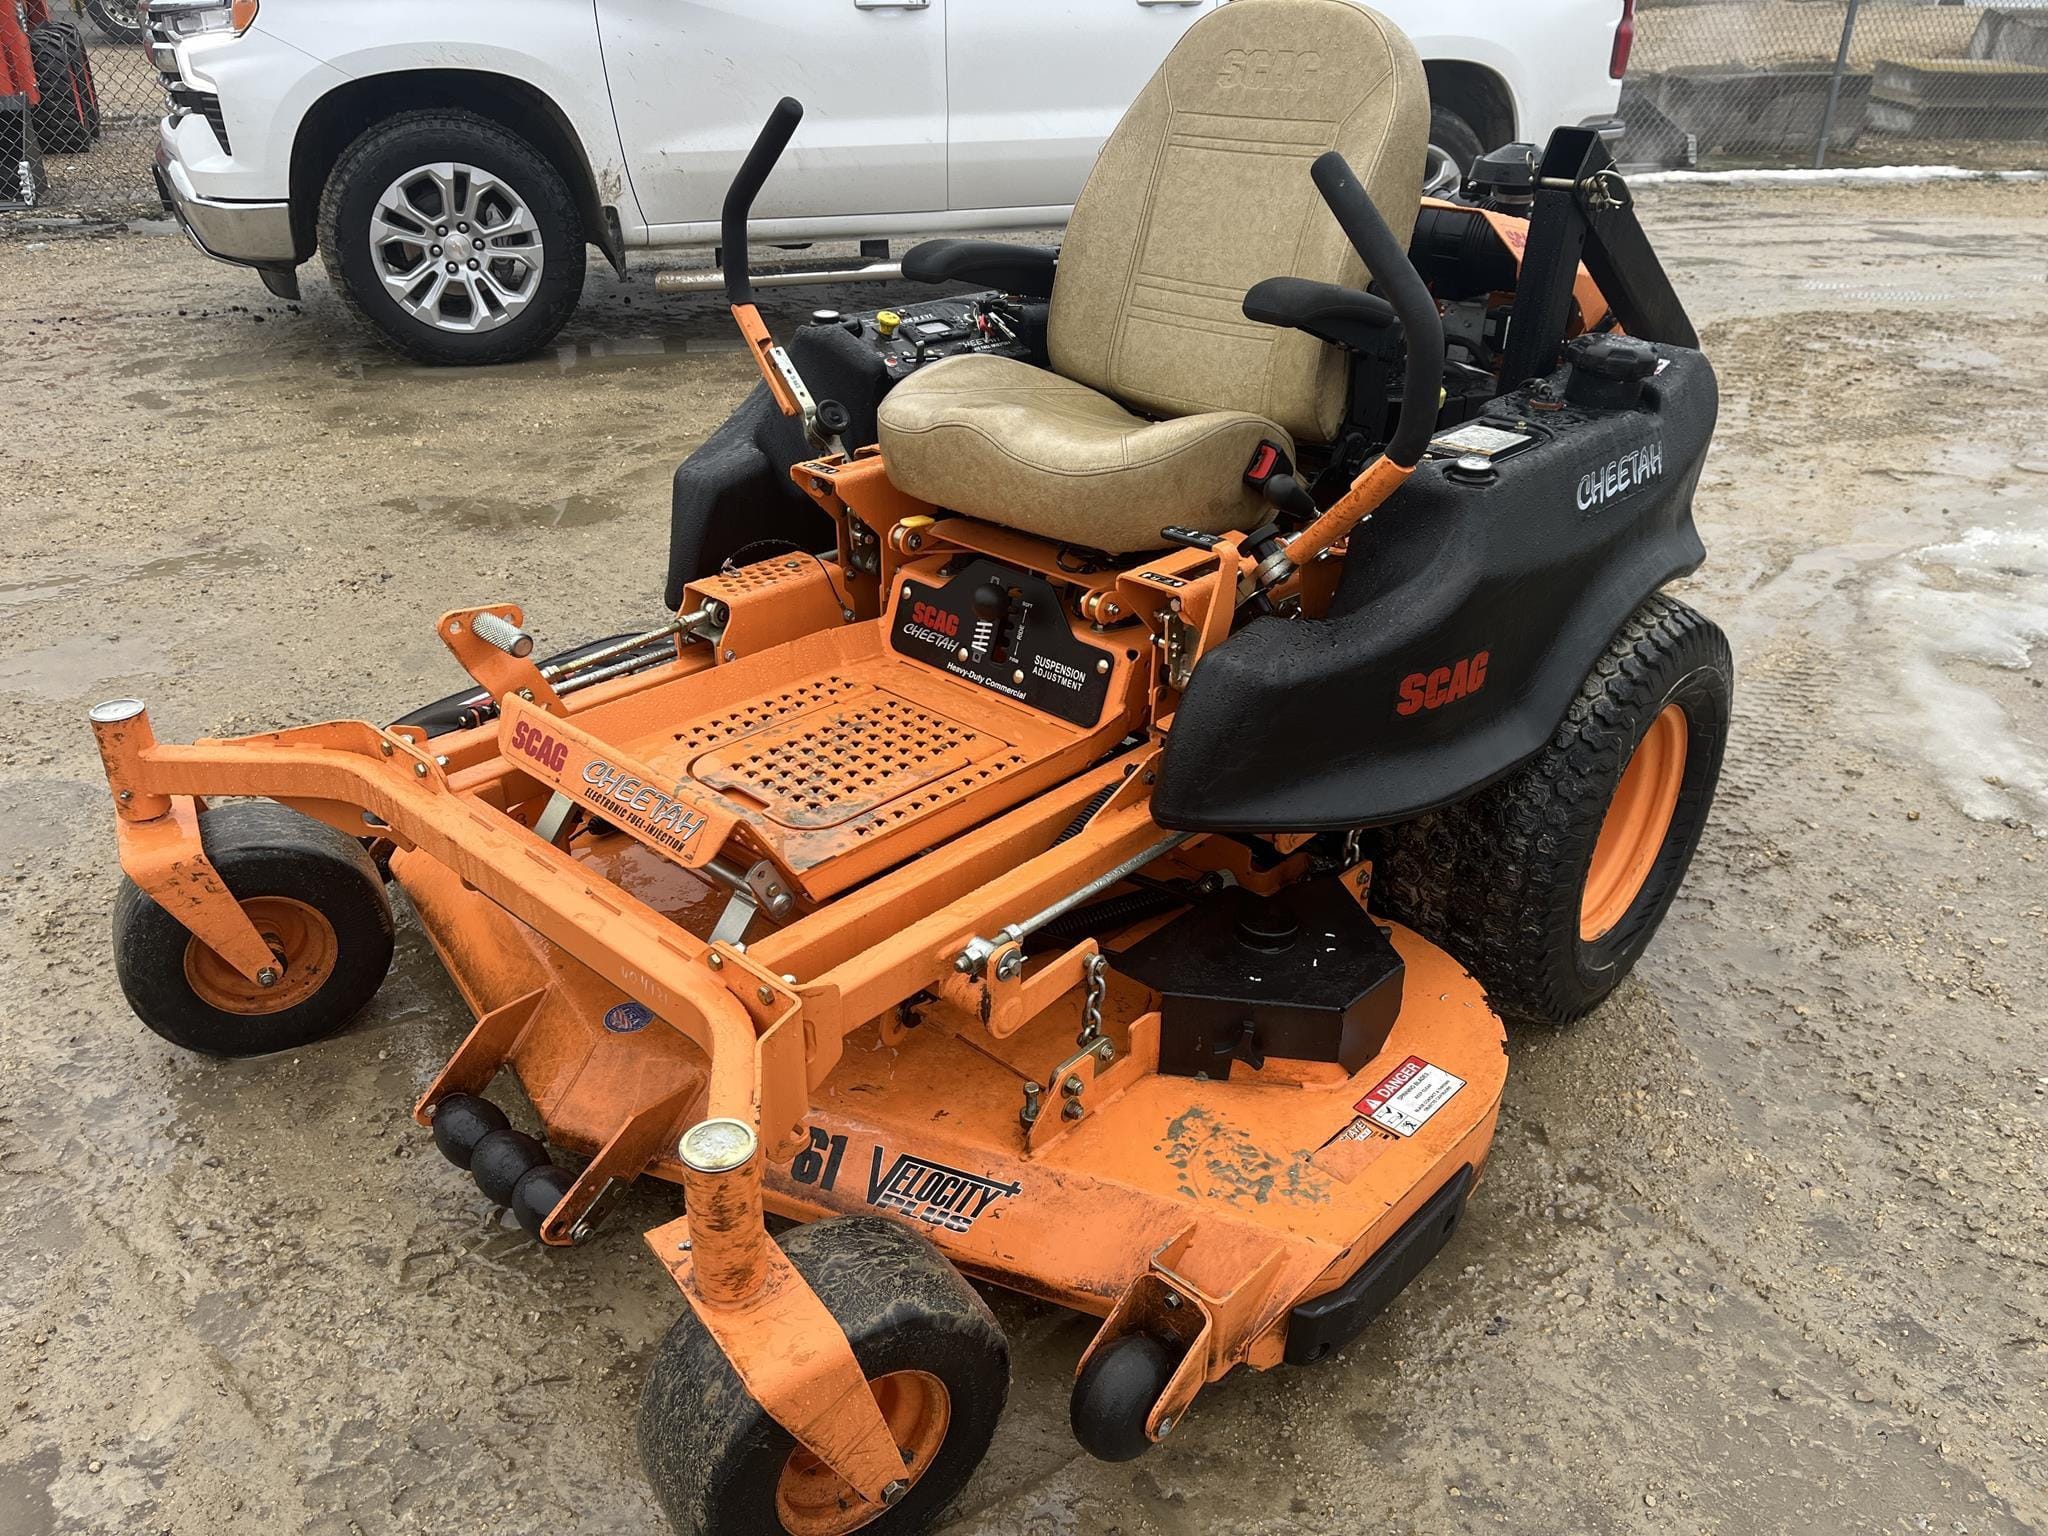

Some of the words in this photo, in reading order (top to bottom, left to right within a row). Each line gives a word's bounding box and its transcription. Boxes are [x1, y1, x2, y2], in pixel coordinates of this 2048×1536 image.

[1216, 48, 1321, 92] SCAG
[1576, 440, 1663, 511] CHEETAH
[903, 623, 960, 653] CHEETAH
[912, 601, 960, 637] SCAG
[947, 661, 985, 684] Heavy-Duty
[985, 678, 1026, 700] Commercial
[1032, 665, 1083, 692] ADJUSTMENT
[1034, 655, 1087, 683] SUSPENSION
[1396, 650, 1489, 716] SCAG
[512, 720, 568, 773] SCAG
[582, 759, 705, 842] CHEETAH
[584, 787, 626, 819] ELECTRONIC
[625, 811, 686, 853] FUEL-INJECTION
[1376, 1062, 1421, 1099] DANGER
[790, 1126, 849, 1192] 61
[877, 1192, 974, 1236] PLUS
